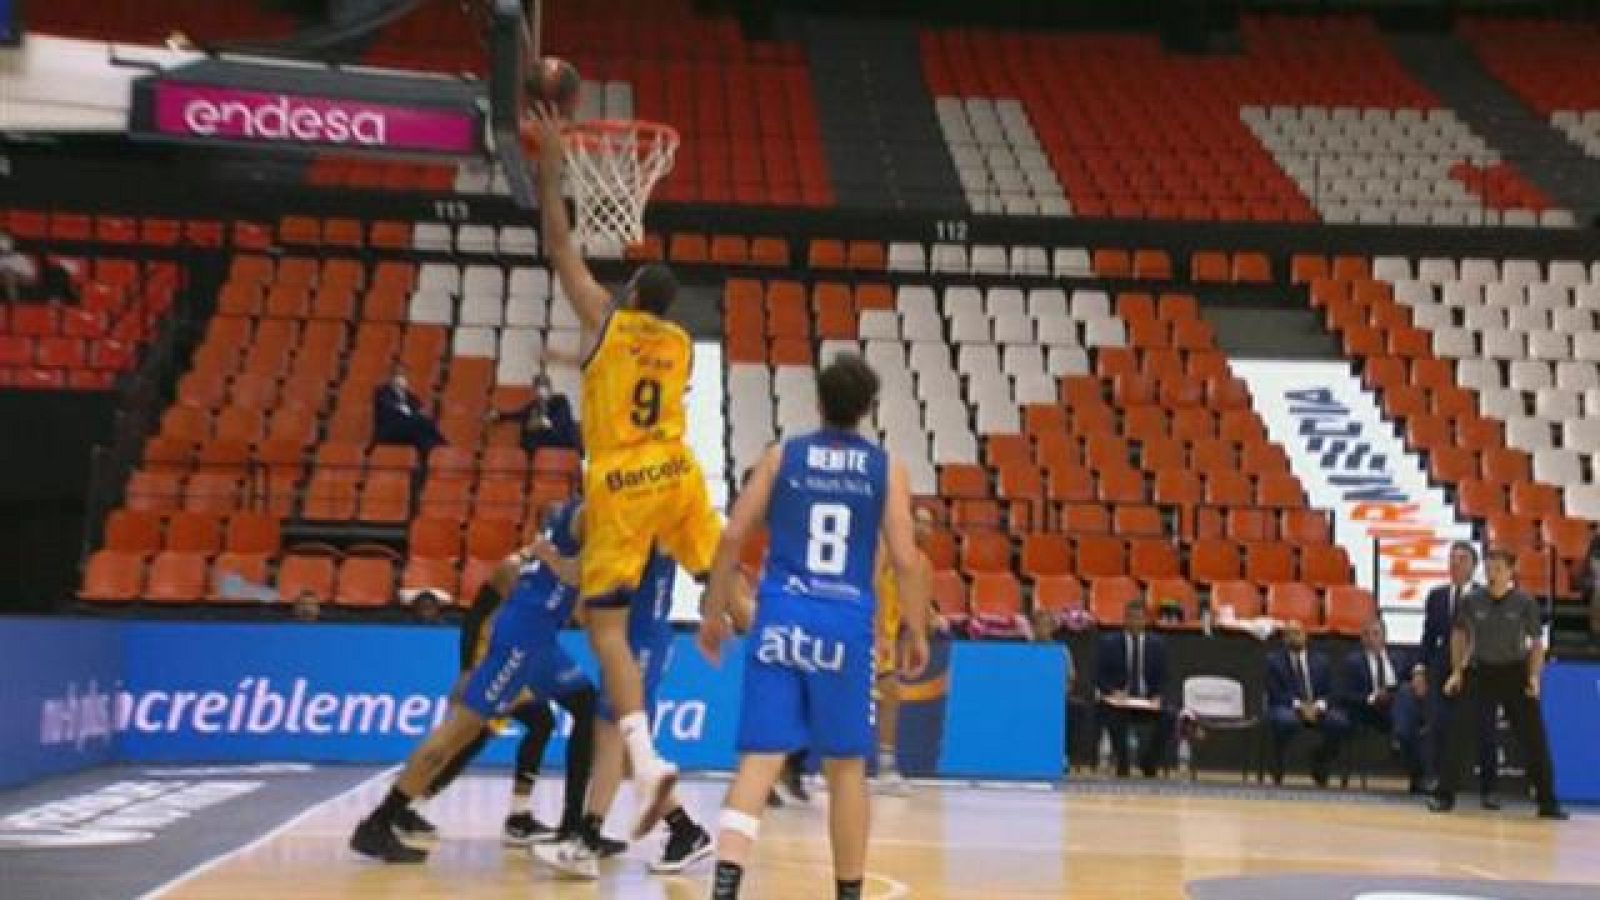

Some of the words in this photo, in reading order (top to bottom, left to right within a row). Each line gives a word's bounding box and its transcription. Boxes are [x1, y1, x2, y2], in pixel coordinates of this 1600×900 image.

[183, 96, 386, 145] endesa
[936, 220, 968, 240] 112
[630, 377, 661, 428] 9
[805, 502, 852, 576] 8
[756, 625, 846, 674] atu
